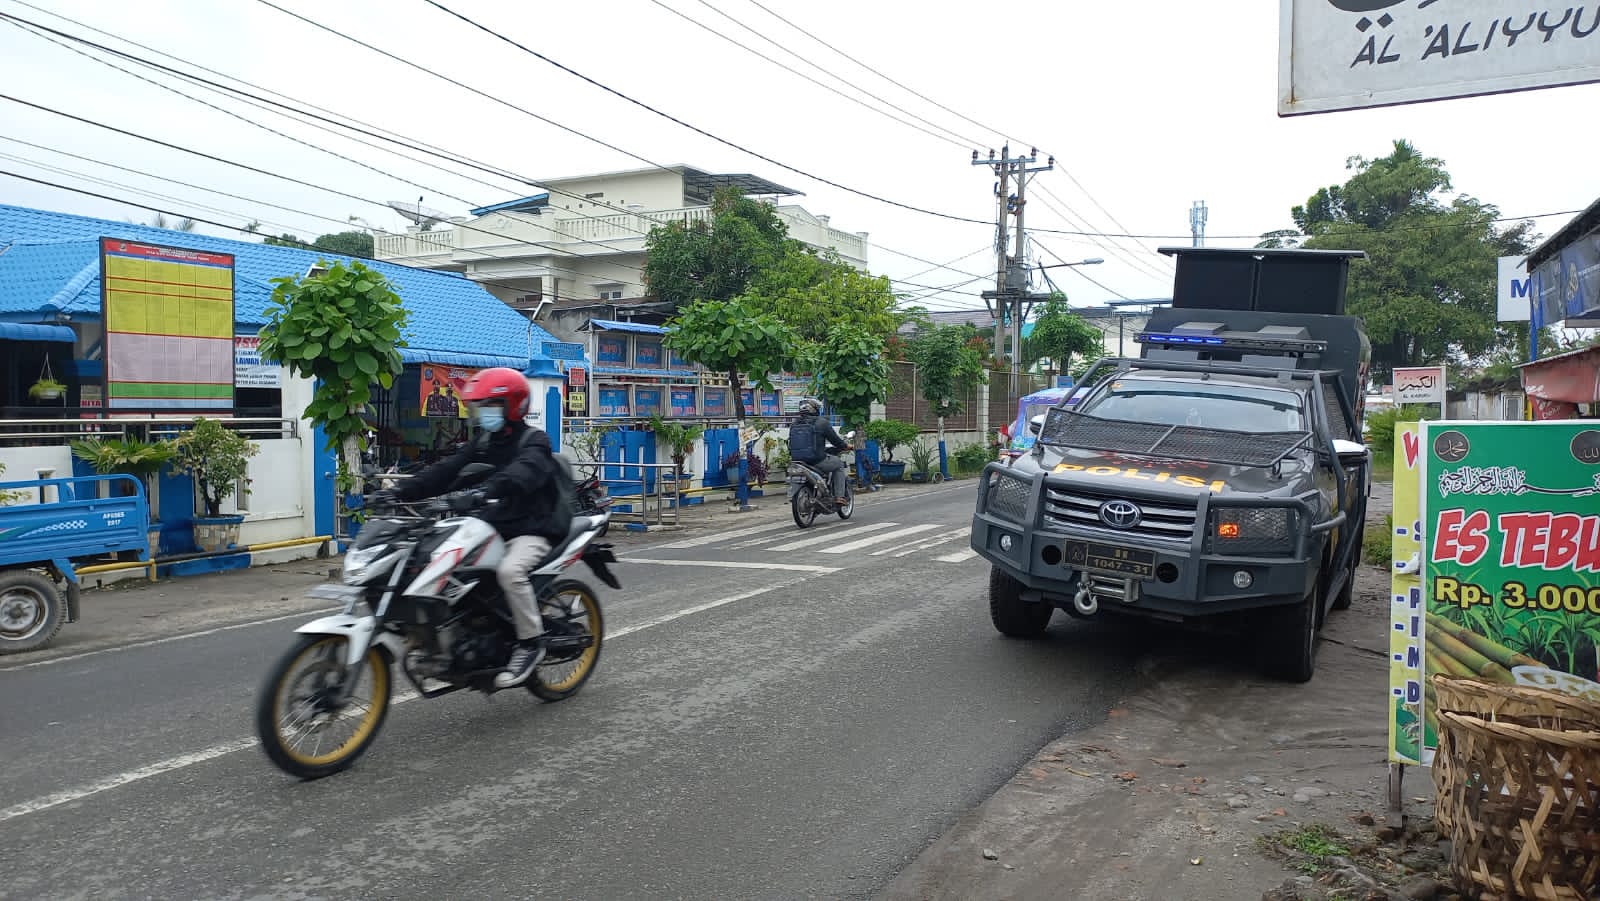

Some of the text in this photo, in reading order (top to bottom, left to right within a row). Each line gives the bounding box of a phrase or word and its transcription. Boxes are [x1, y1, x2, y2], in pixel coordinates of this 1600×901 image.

[1350, 34, 1400, 68] AL
[1053, 463, 1226, 493] POLISI
[1432, 509, 1490, 566] ES
[1434, 576, 1493, 609] Rp.
